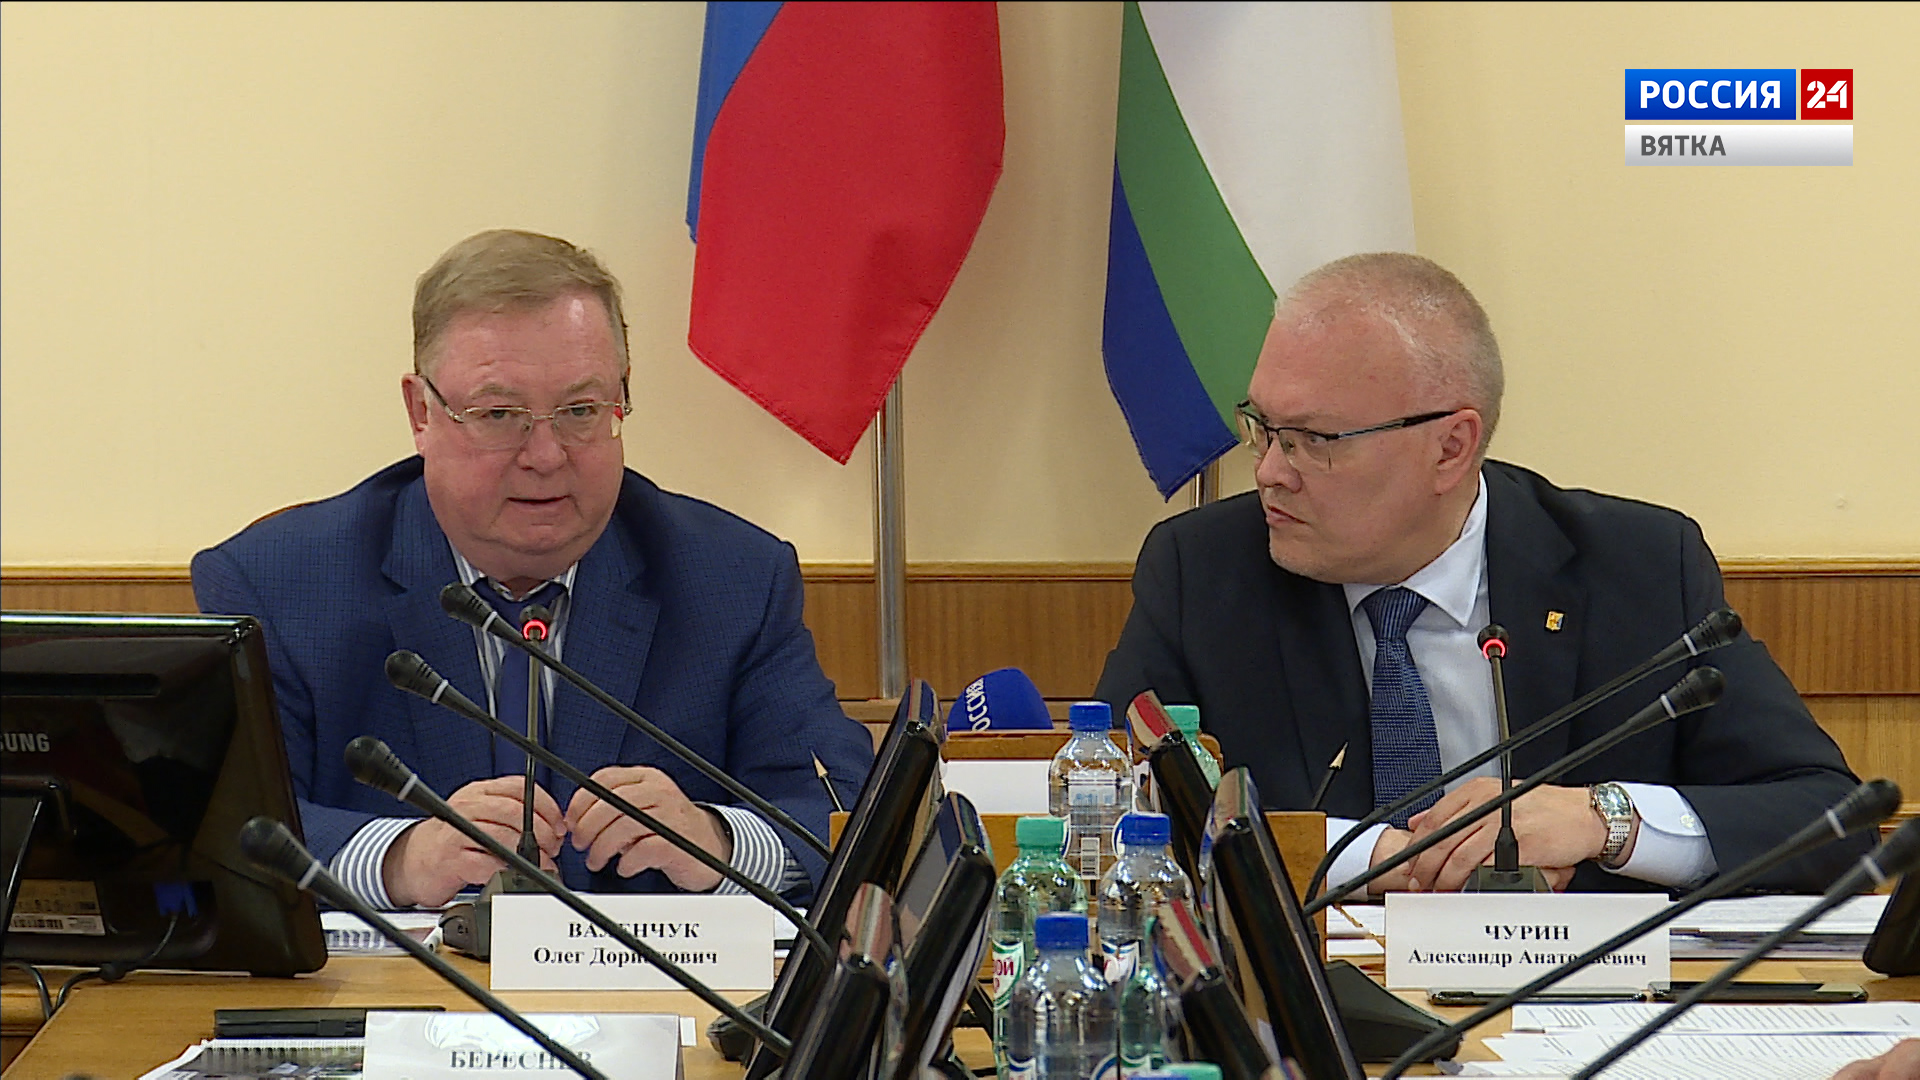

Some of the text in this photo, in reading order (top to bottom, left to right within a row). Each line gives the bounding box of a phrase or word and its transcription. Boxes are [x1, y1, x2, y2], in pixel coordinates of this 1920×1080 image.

[965, 677, 991, 731] ОССИЯ
[0, 732, 50, 752] UNG
[568, 922, 700, 938] ВАНЧУК
[1484, 924, 1570, 941] ЧУРИН
[533, 946, 718, 968] Олег Дориович
[1408, 948, 1647, 968] Александр Анатоевич
[450, 1050, 593, 1070] БЕРЕСНВ
